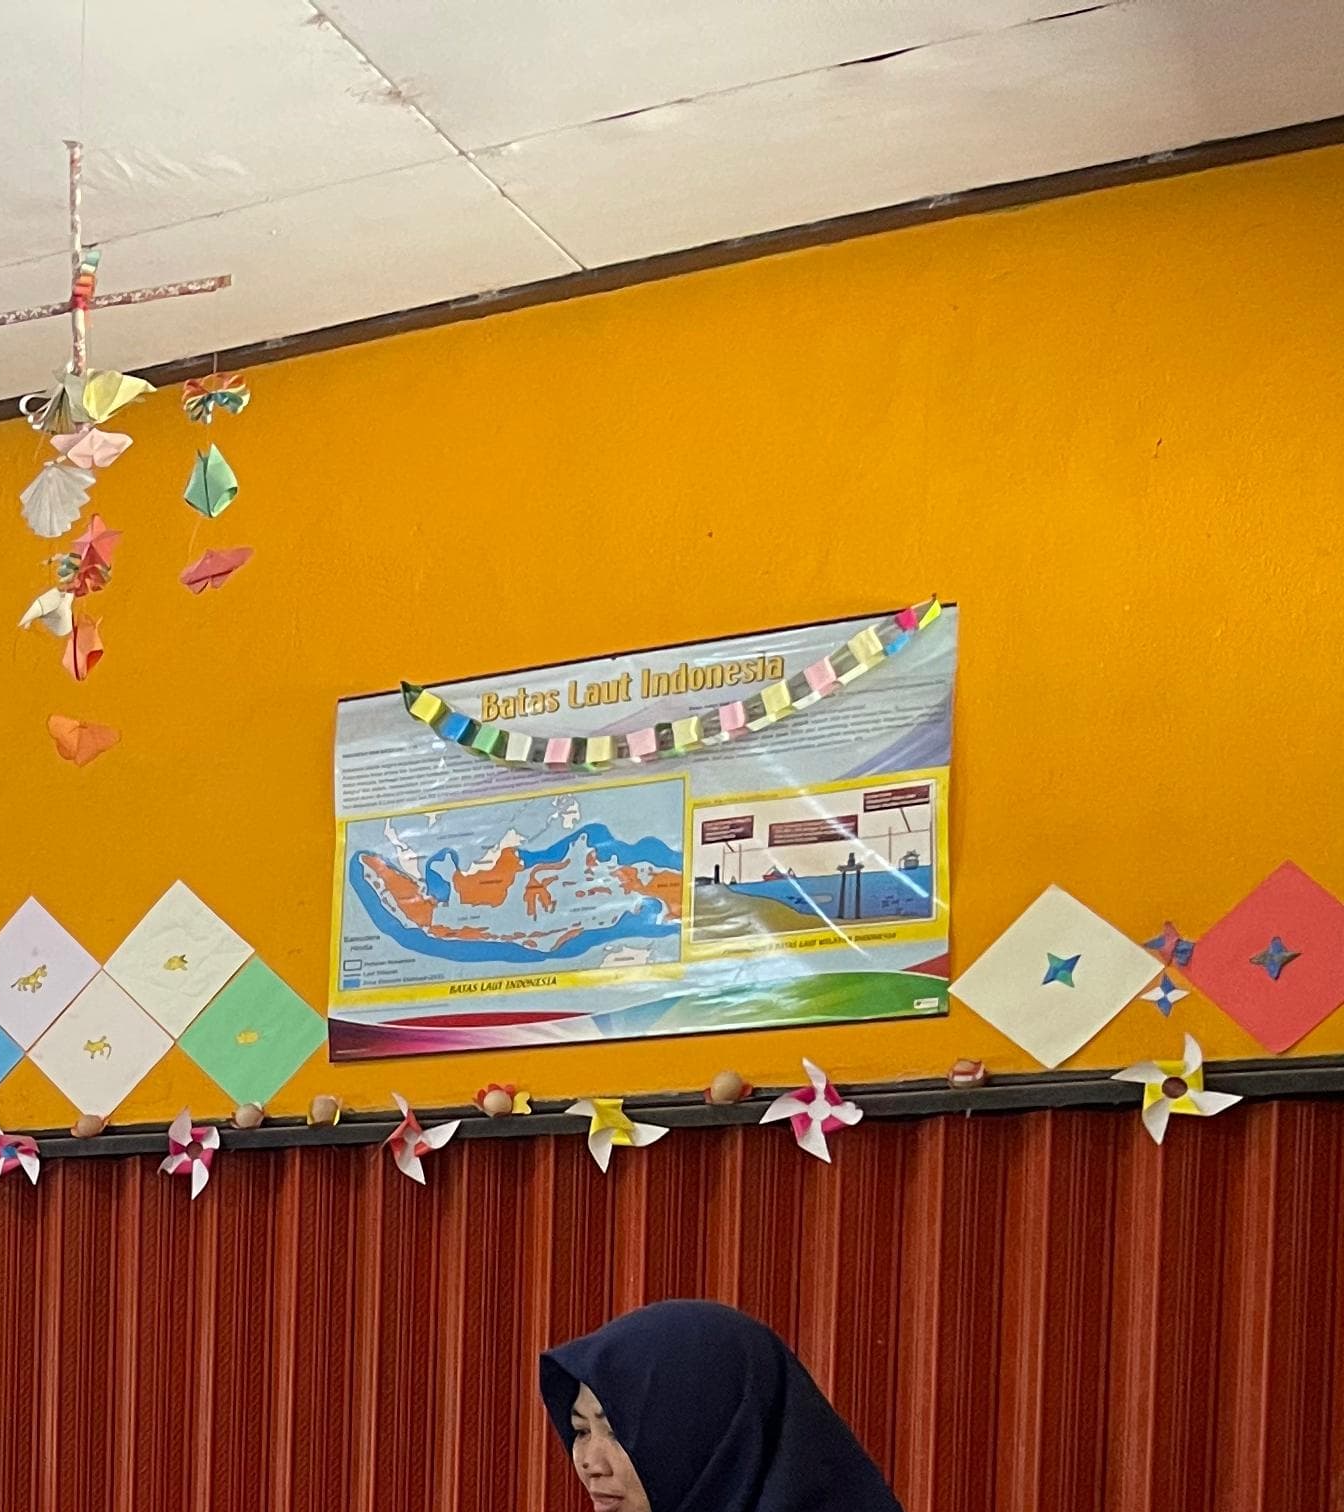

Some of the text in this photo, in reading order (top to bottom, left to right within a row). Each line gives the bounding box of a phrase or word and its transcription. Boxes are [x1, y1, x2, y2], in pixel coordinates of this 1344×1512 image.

[481, 655, 785, 722] Batas Laut Indonesia
[449, 975, 558, 995] BATAS LAUT INDONESIA
